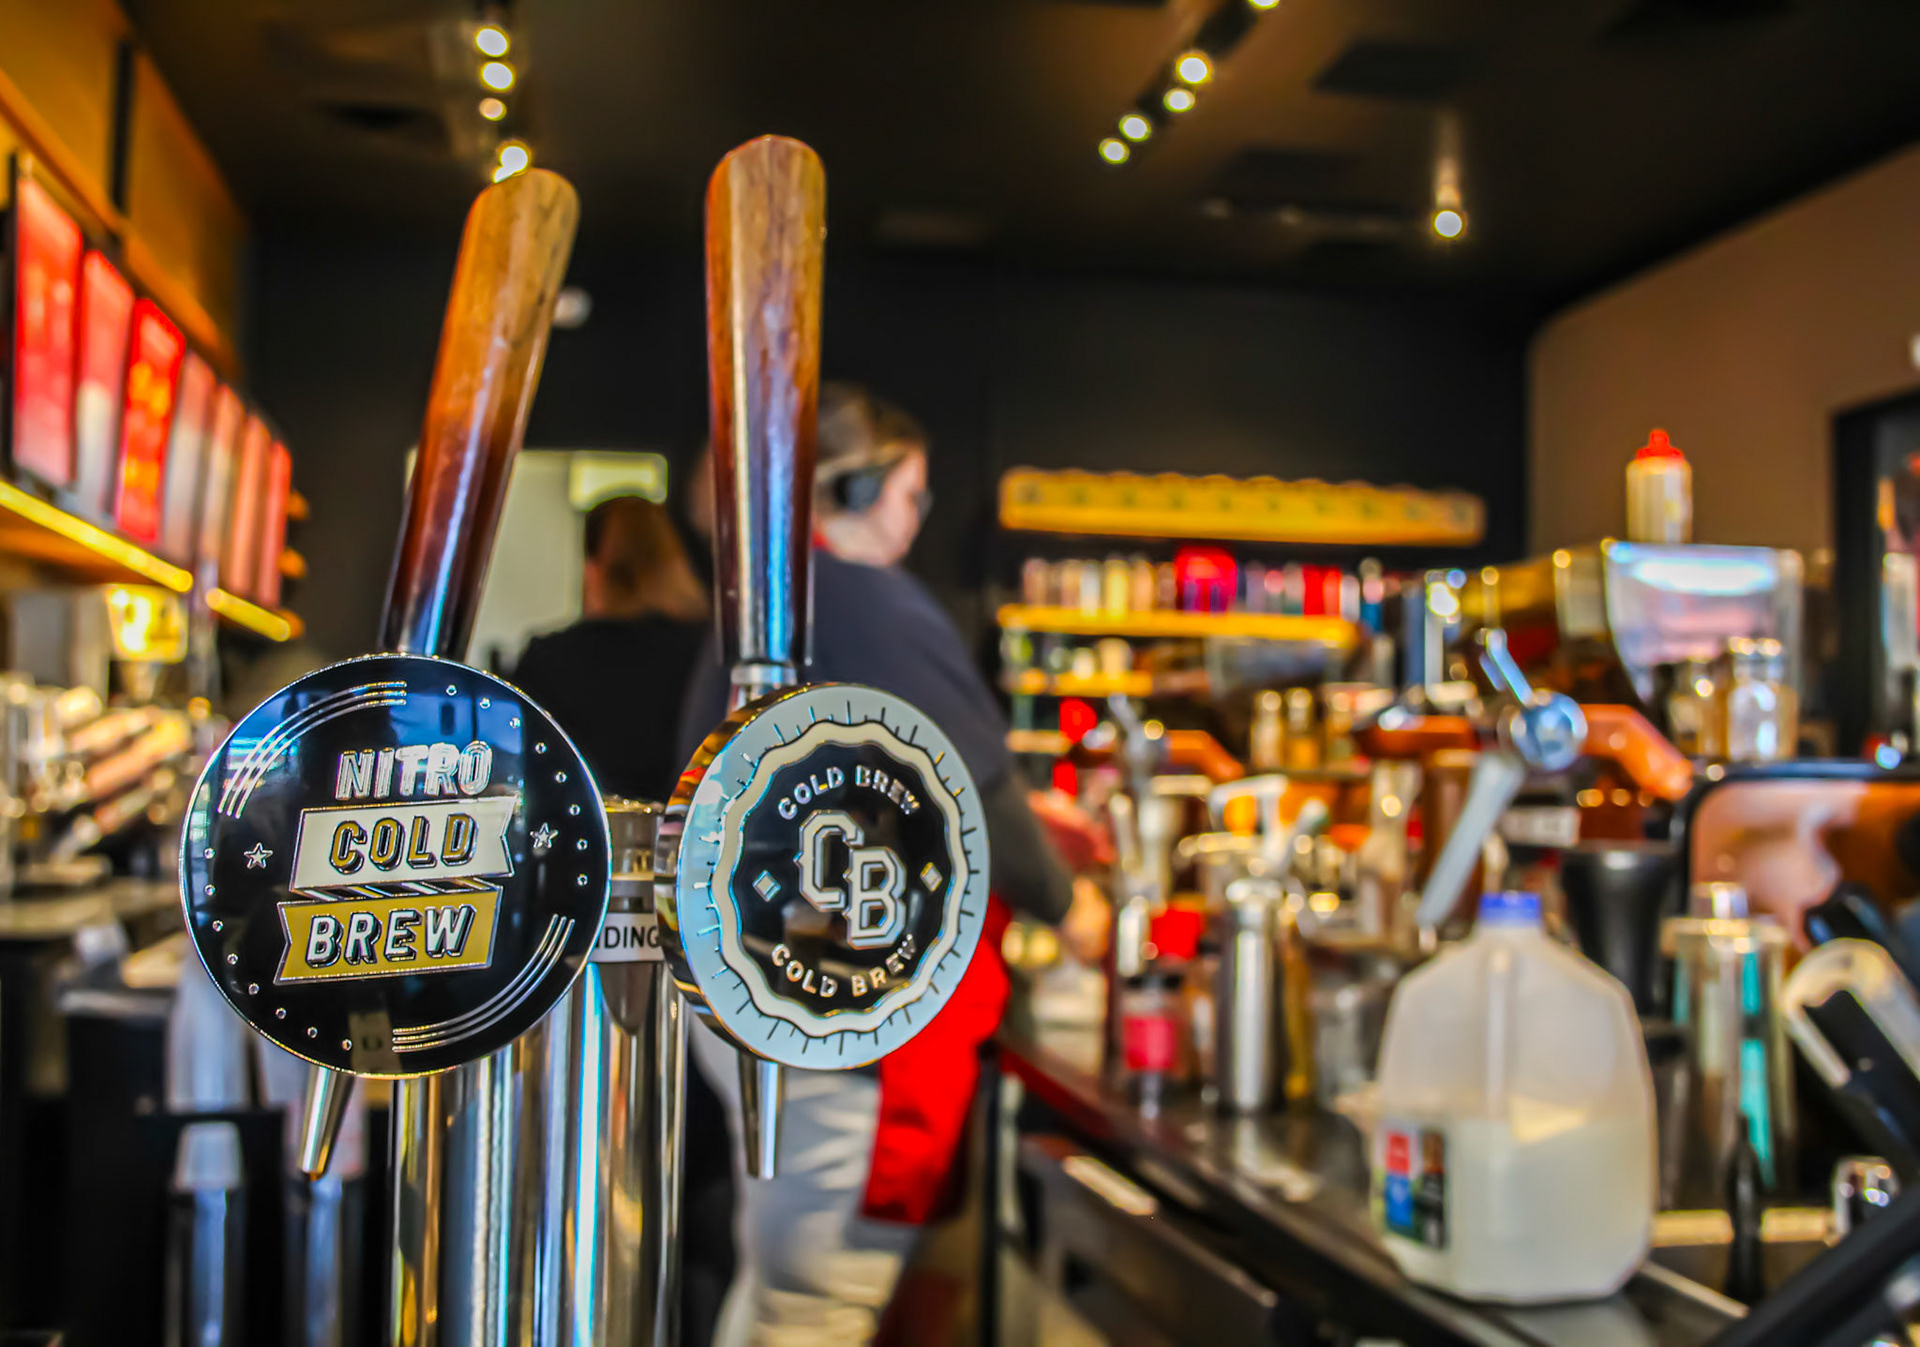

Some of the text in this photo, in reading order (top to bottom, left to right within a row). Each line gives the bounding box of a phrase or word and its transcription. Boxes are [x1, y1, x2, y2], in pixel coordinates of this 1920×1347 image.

[335, 740, 493, 800] NITRO
[778, 765, 920, 820] COLD BREW
[329, 812, 480, 874] COLD
[305, 904, 477, 968] BREW
[595, 926, 660, 949] DING
[771, 933, 916, 998] COLD BREW
